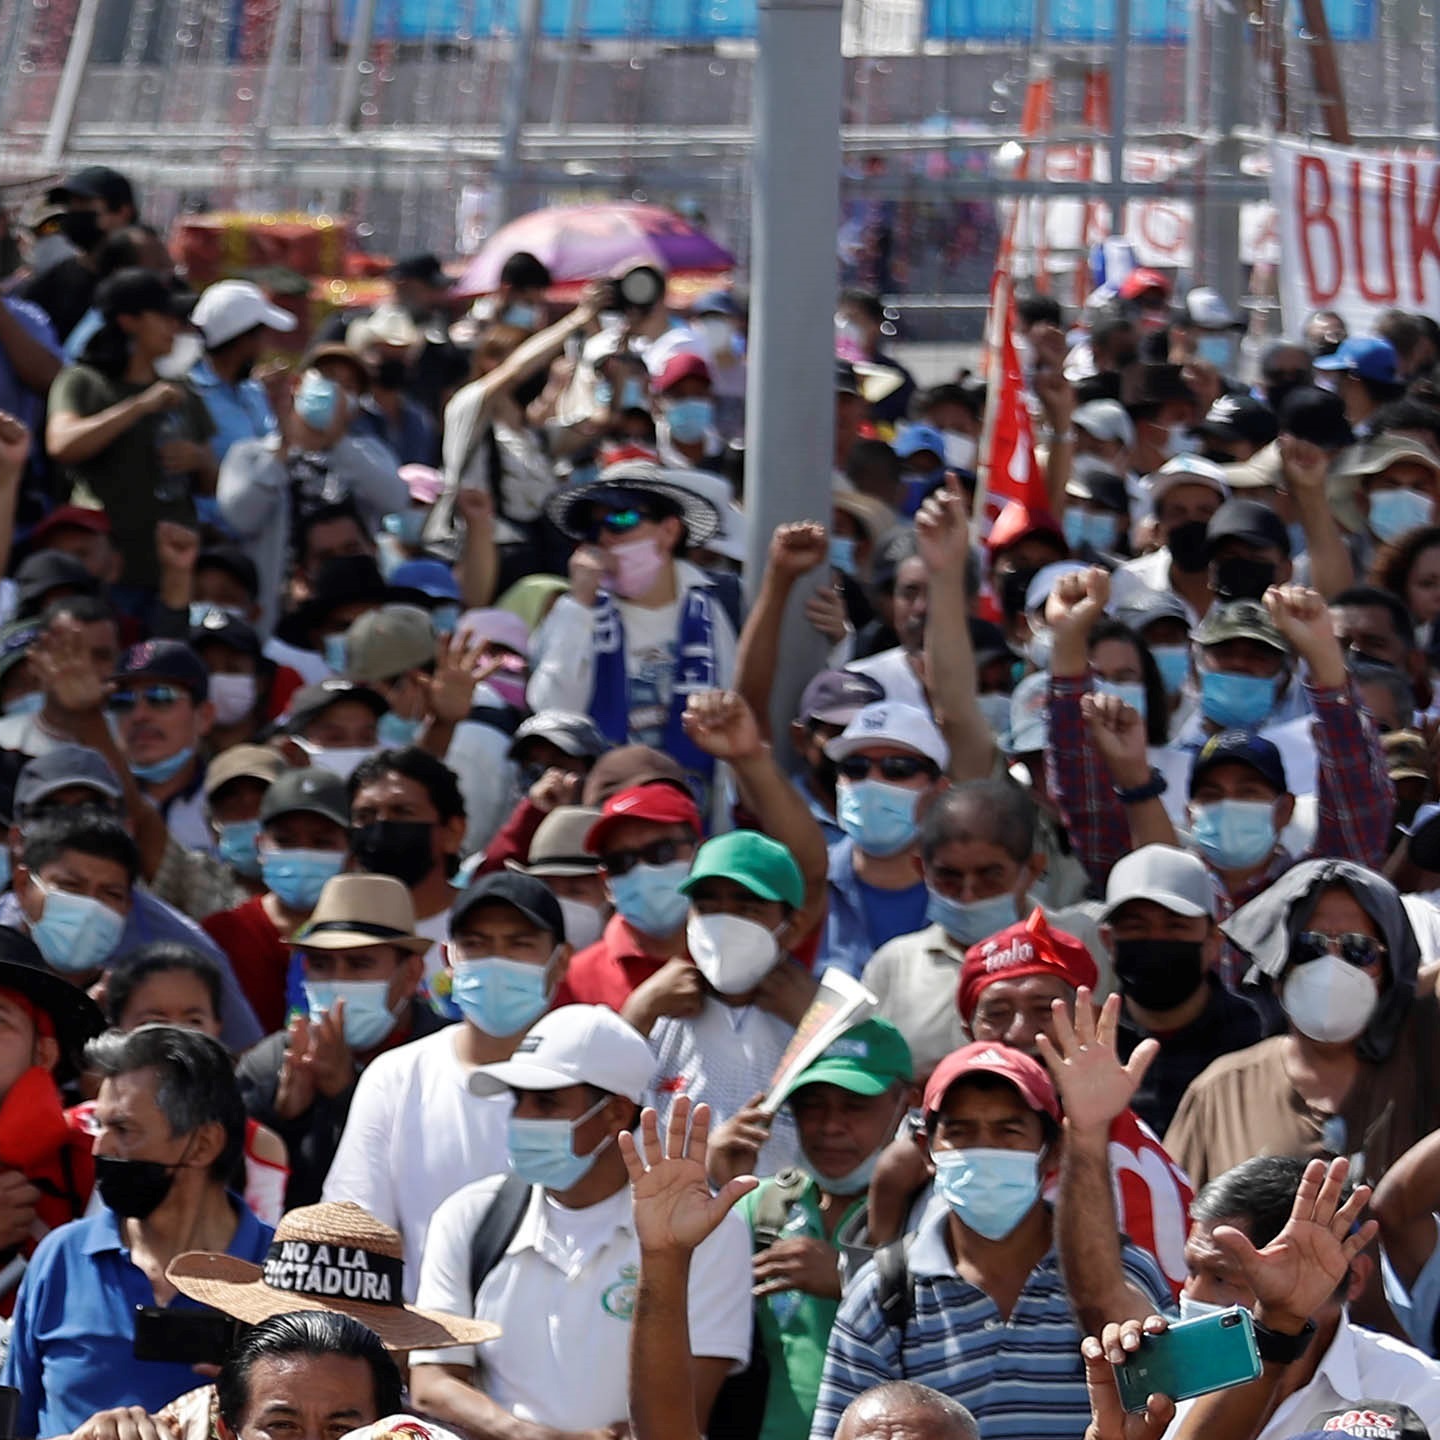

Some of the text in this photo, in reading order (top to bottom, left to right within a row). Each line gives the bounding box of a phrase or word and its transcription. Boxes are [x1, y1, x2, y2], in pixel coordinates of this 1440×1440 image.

[281, 1242, 368, 1270] NO A LA
[264, 1259, 392, 1301] DICTADURA
